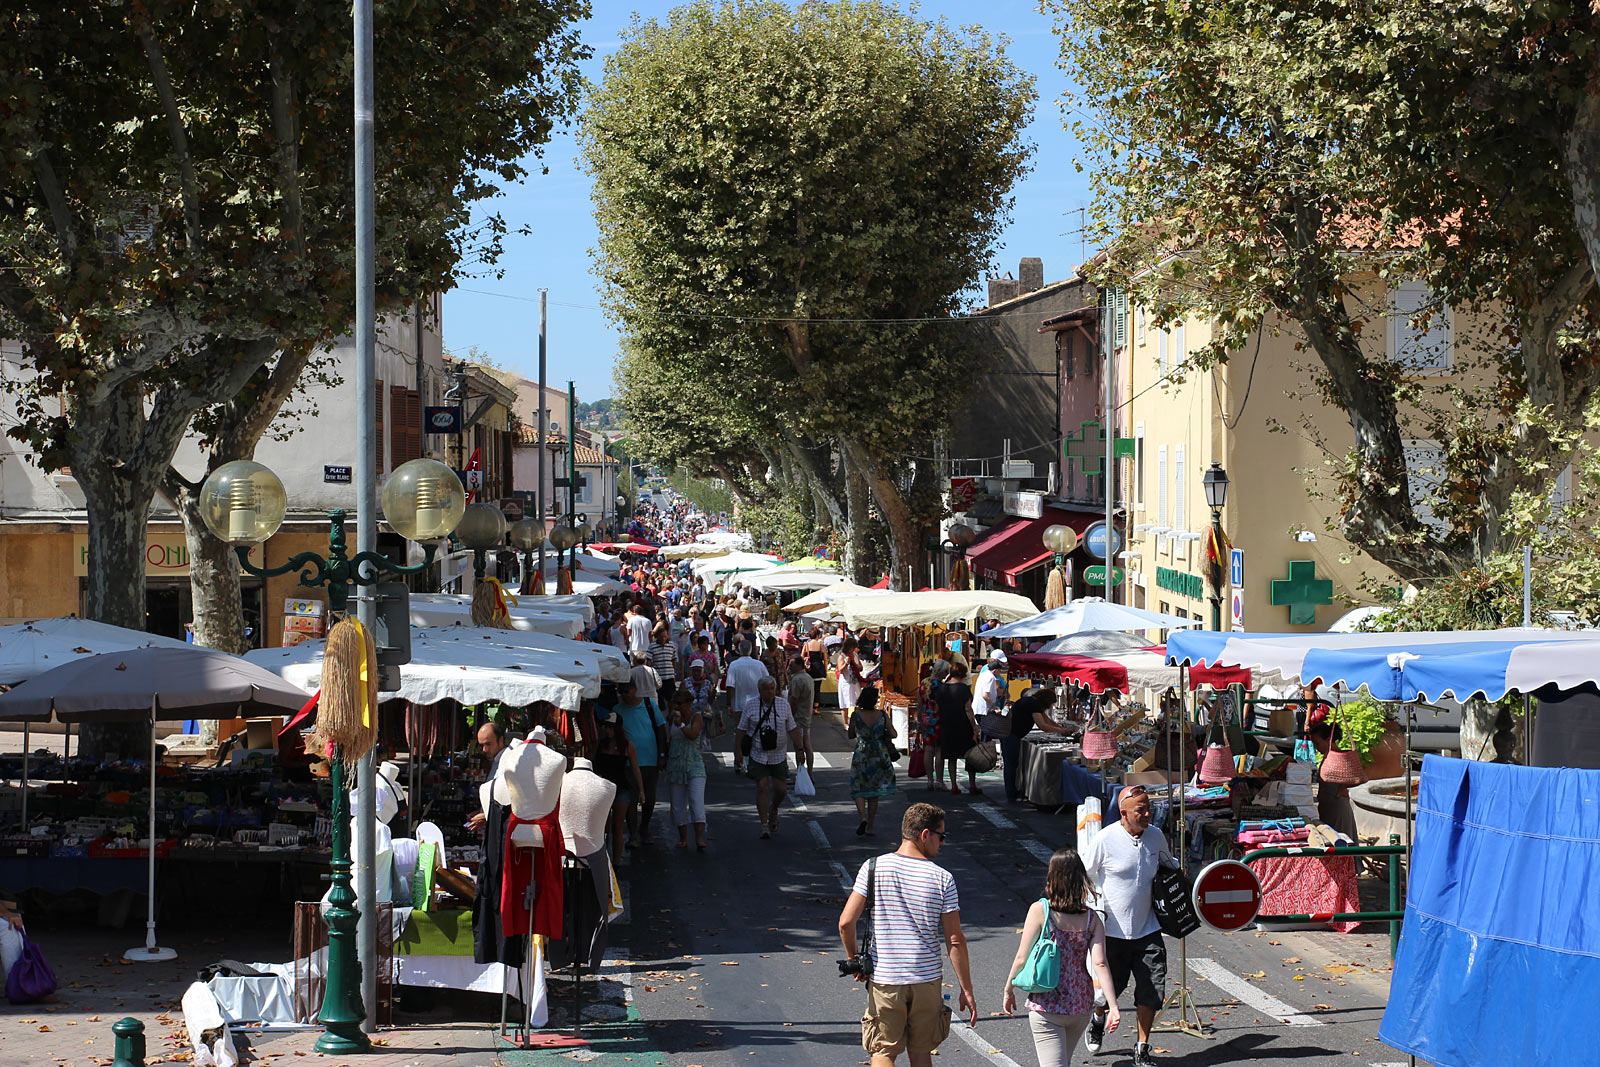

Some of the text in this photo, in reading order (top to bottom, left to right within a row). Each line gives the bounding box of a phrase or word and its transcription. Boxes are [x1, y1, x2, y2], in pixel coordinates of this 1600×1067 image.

[433, 415, 452, 424] 1664
[1087, 572, 1107, 580] PMU
[1175, 902, 1187, 914] HUF
